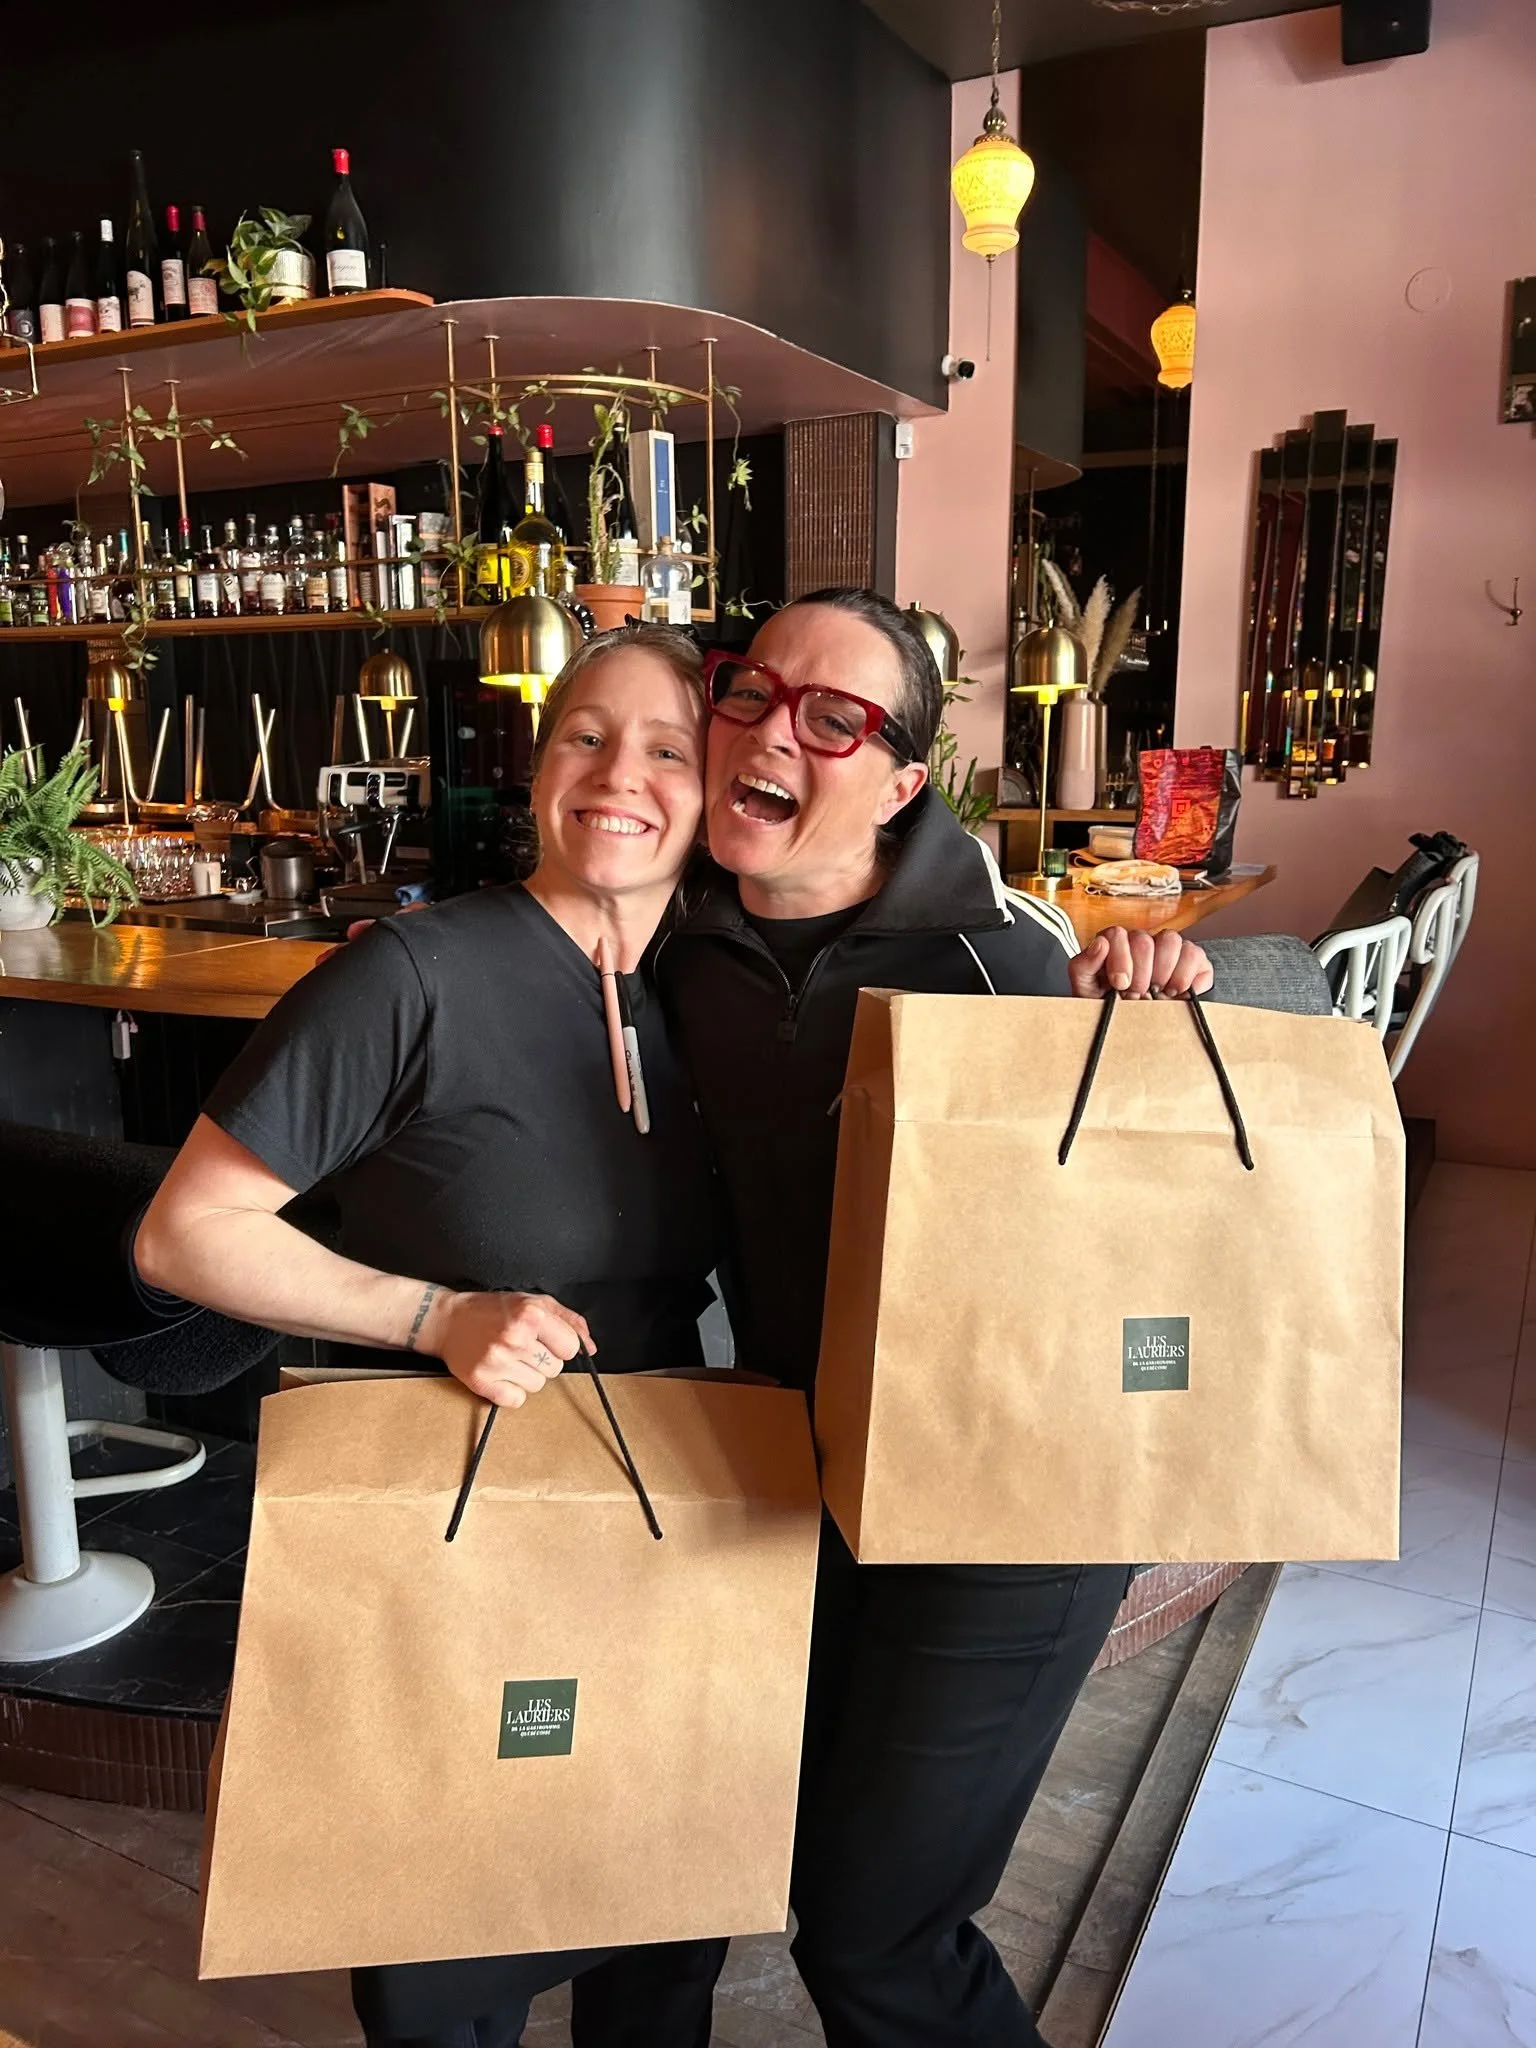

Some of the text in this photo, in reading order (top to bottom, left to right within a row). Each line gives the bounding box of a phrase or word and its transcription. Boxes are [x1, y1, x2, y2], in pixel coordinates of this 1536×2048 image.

[1146, 1335, 1167, 1348] LES
[1128, 1345, 1185, 1359] LAURIERS
[528, 1698, 551, 1712] LES
[507, 1708, 570, 1724] LAURIERS
